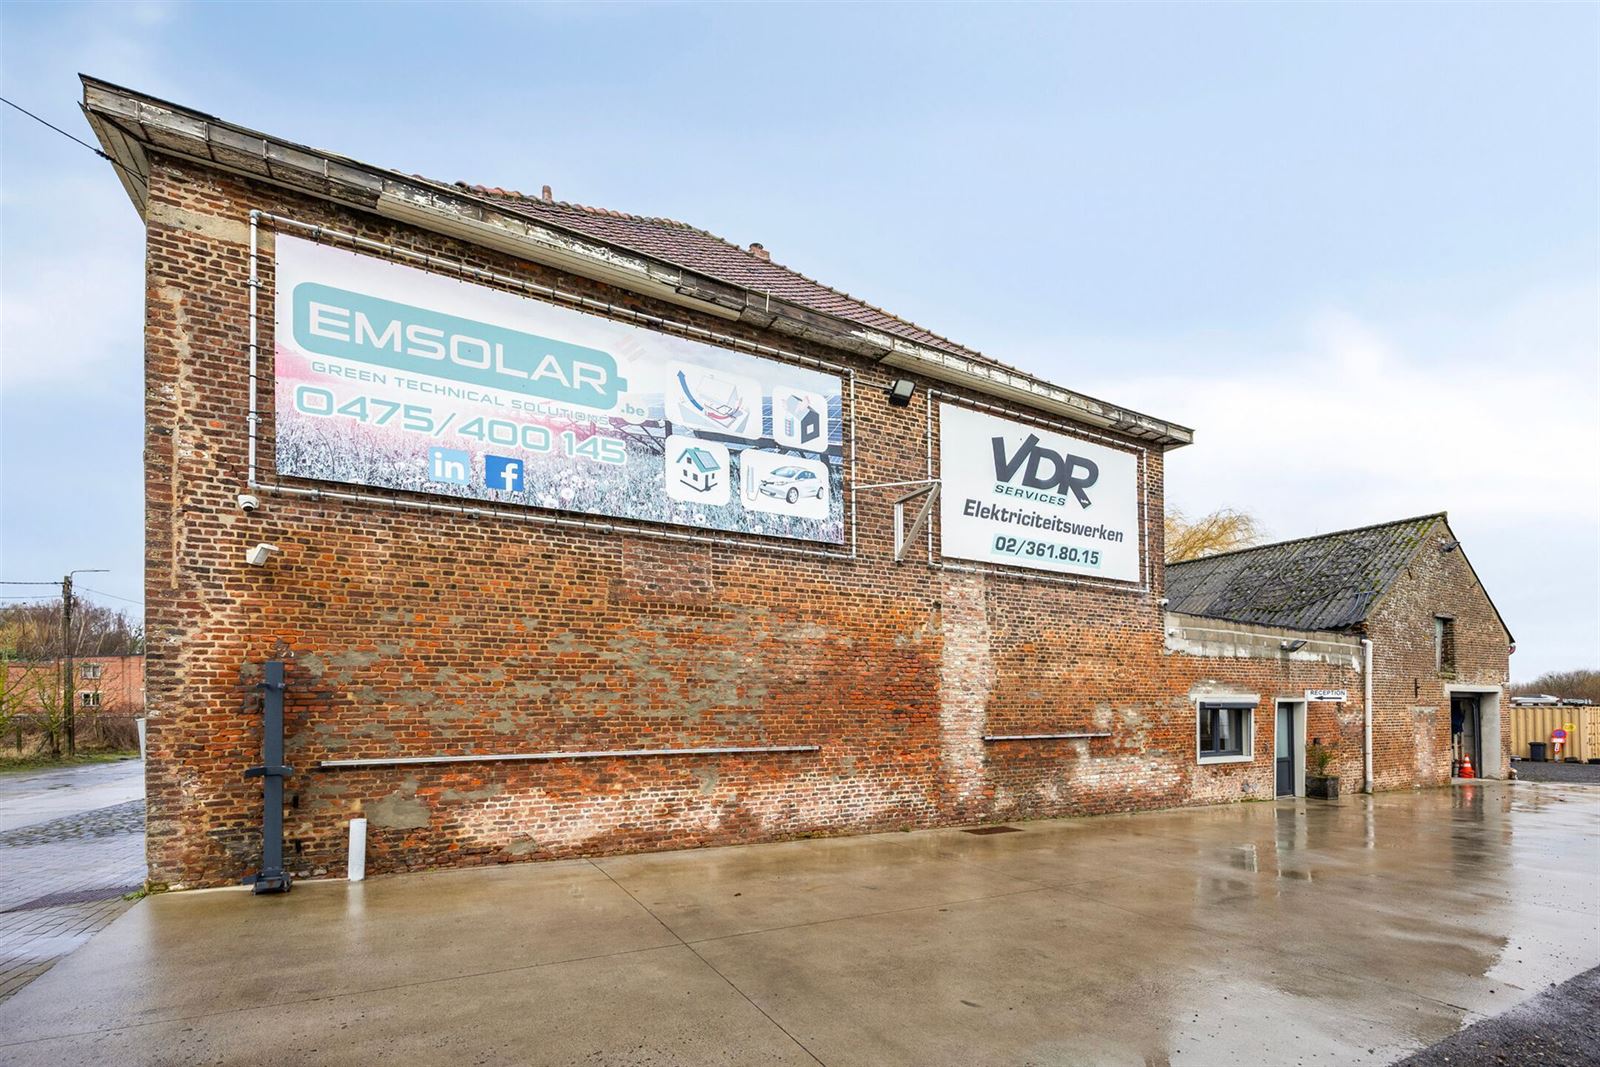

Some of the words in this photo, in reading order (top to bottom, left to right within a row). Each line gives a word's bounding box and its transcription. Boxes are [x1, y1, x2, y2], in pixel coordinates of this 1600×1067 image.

[308, 301, 608, 396] EMSOLAR
[311, 361, 387, 385] GREEN
[393, 376, 505, 407] TECHNICAL
[511, 399, 609, 426] SOLUTIONS
[295, 386, 552, 452] 0475/400
[562, 431, 628, 466] 145
[434, 452, 465, 481] in
[500, 463, 519, 491] f
[992, 434, 1099, 509] VDR
[994, 484, 1067, 507] SERVICES
[963, 498, 1124, 543] Elektriciteitswerken
[995, 536, 1100, 565] 02/361.80.15
